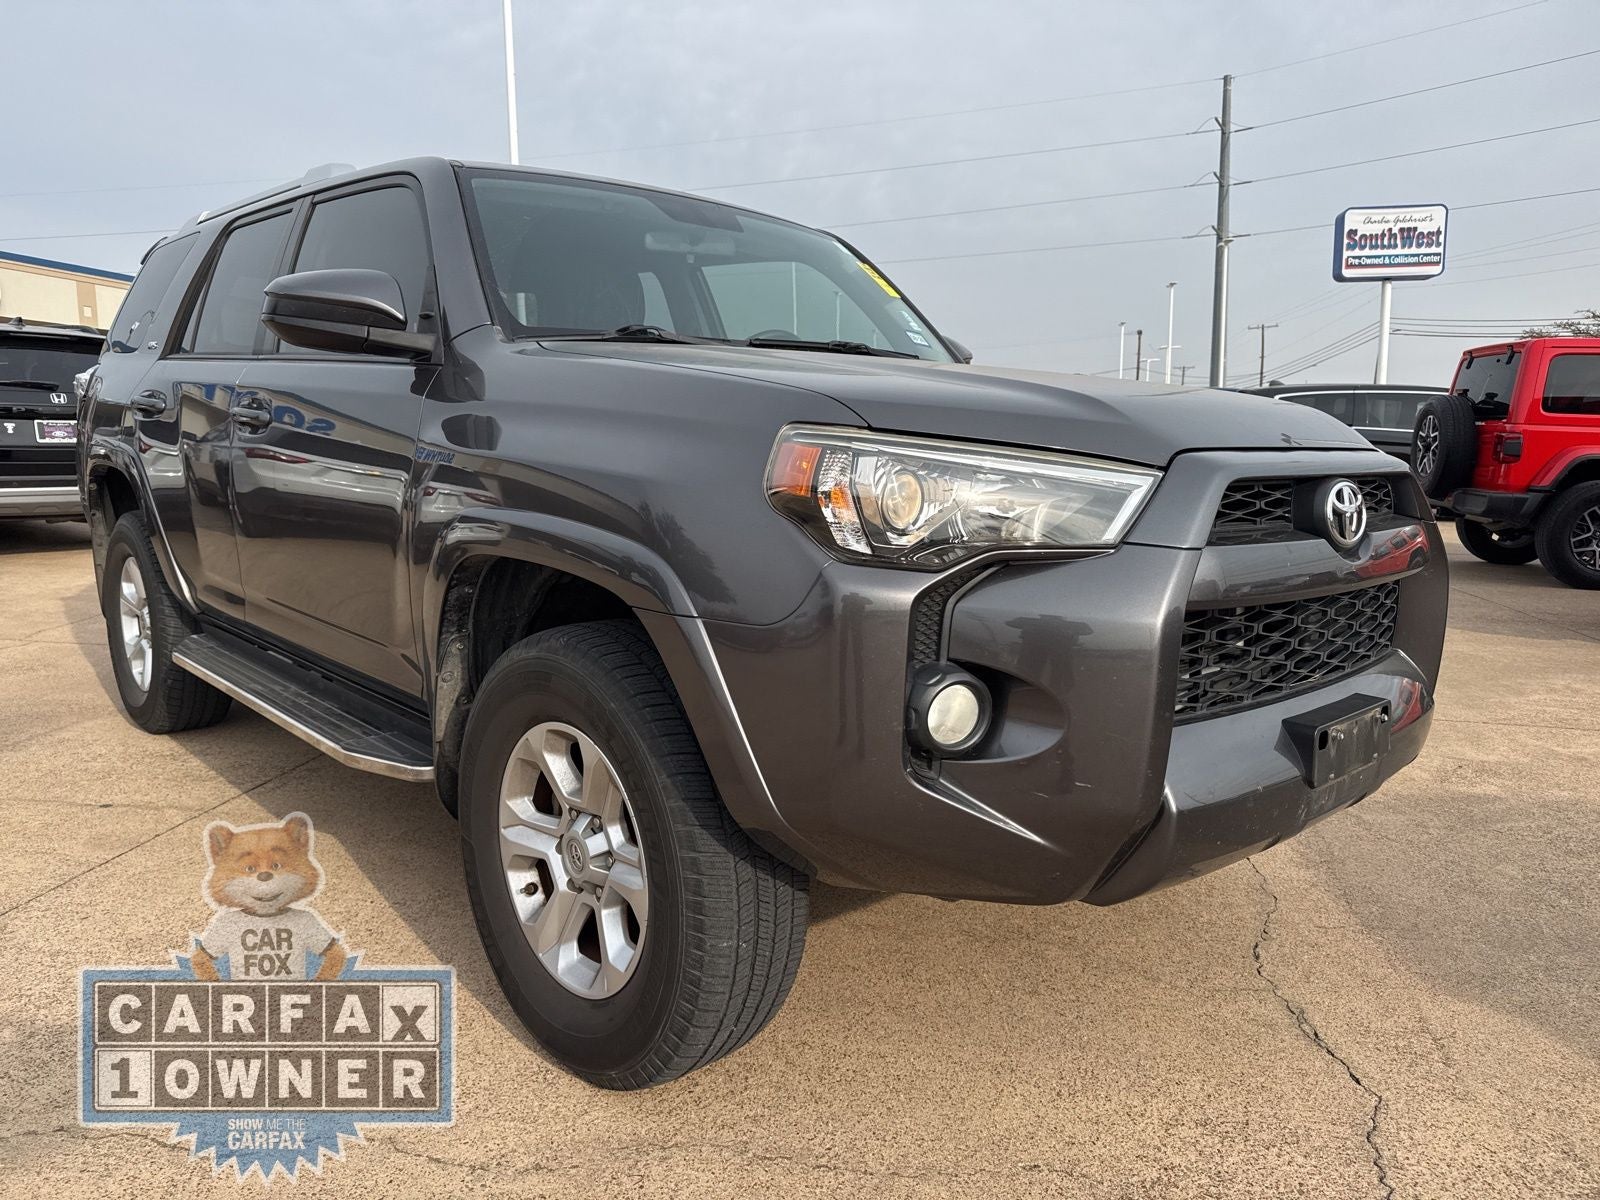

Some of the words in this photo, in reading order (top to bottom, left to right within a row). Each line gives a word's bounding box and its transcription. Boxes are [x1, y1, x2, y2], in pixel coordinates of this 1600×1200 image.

[1362, 215, 1391, 225] Charlie
[1347, 256, 1382, 265] Pre-Owned
[1384, 256, 1390, 264] &
[1390, 254, 1418, 264] Collision
[1419, 253, 1441, 263] Center
